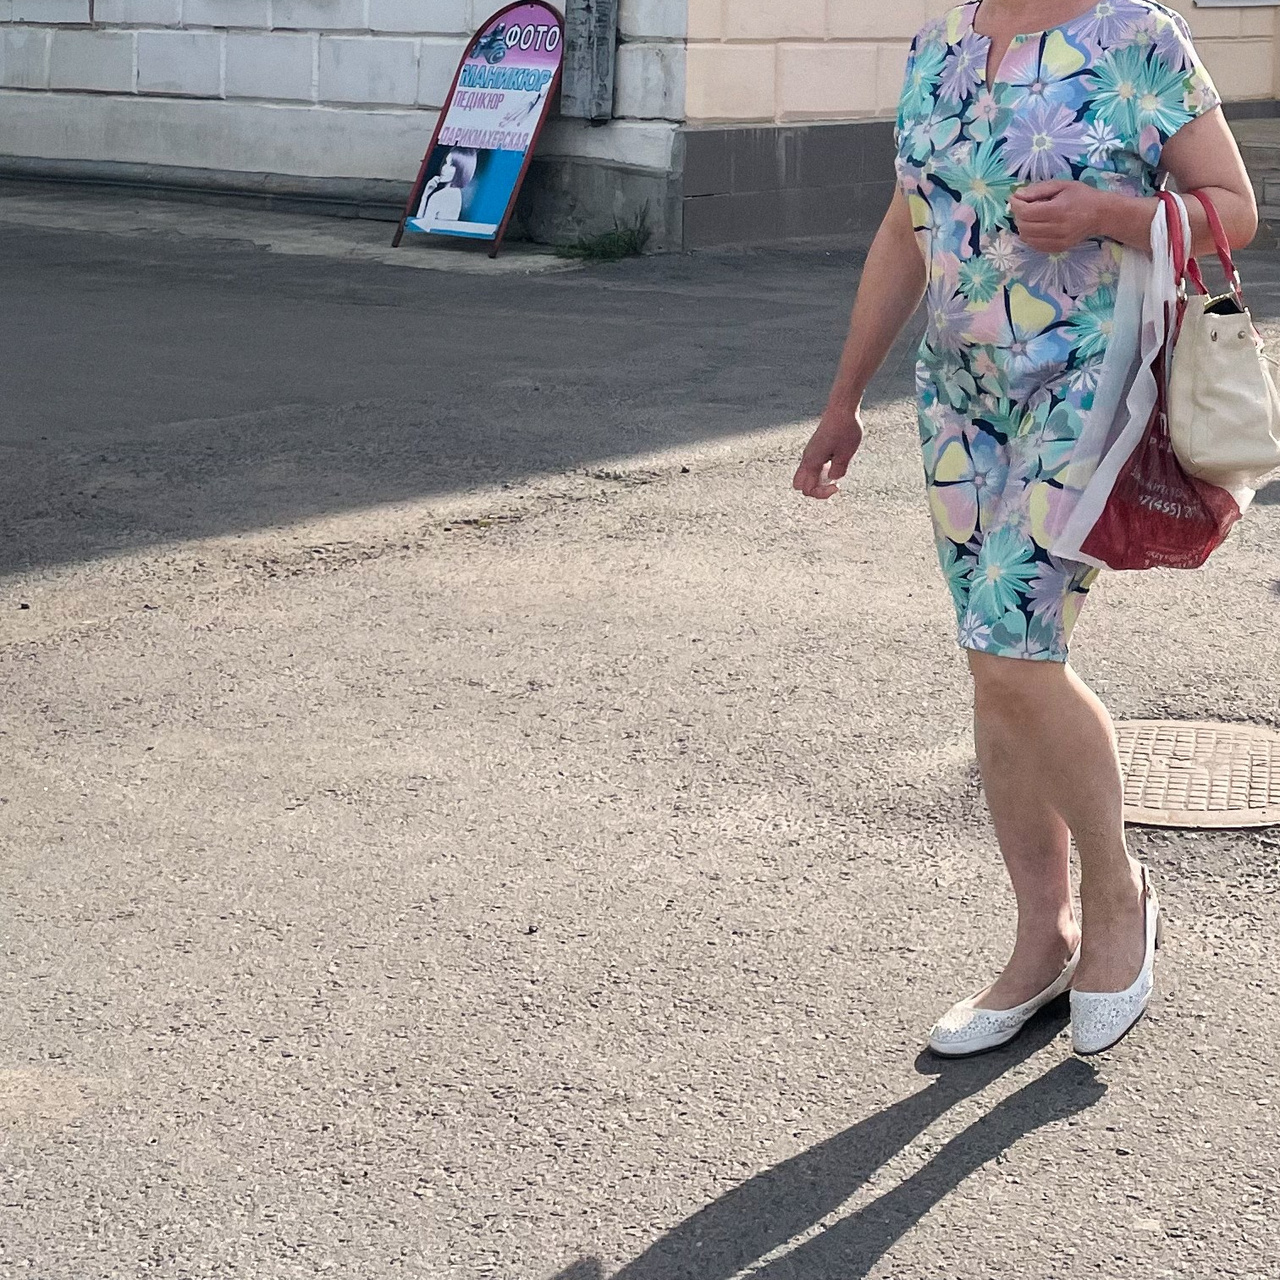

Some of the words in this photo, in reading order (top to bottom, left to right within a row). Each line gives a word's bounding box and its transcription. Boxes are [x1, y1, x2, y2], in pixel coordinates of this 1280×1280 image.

[505, 24, 561, 51] ФОТО
[459, 64, 552, 92] МАНИКЮР
[453, 90, 505, 112] ПЕДИКЮР
[440, 126, 529, 150] ПАРИКМАХЕРСКАЯ
